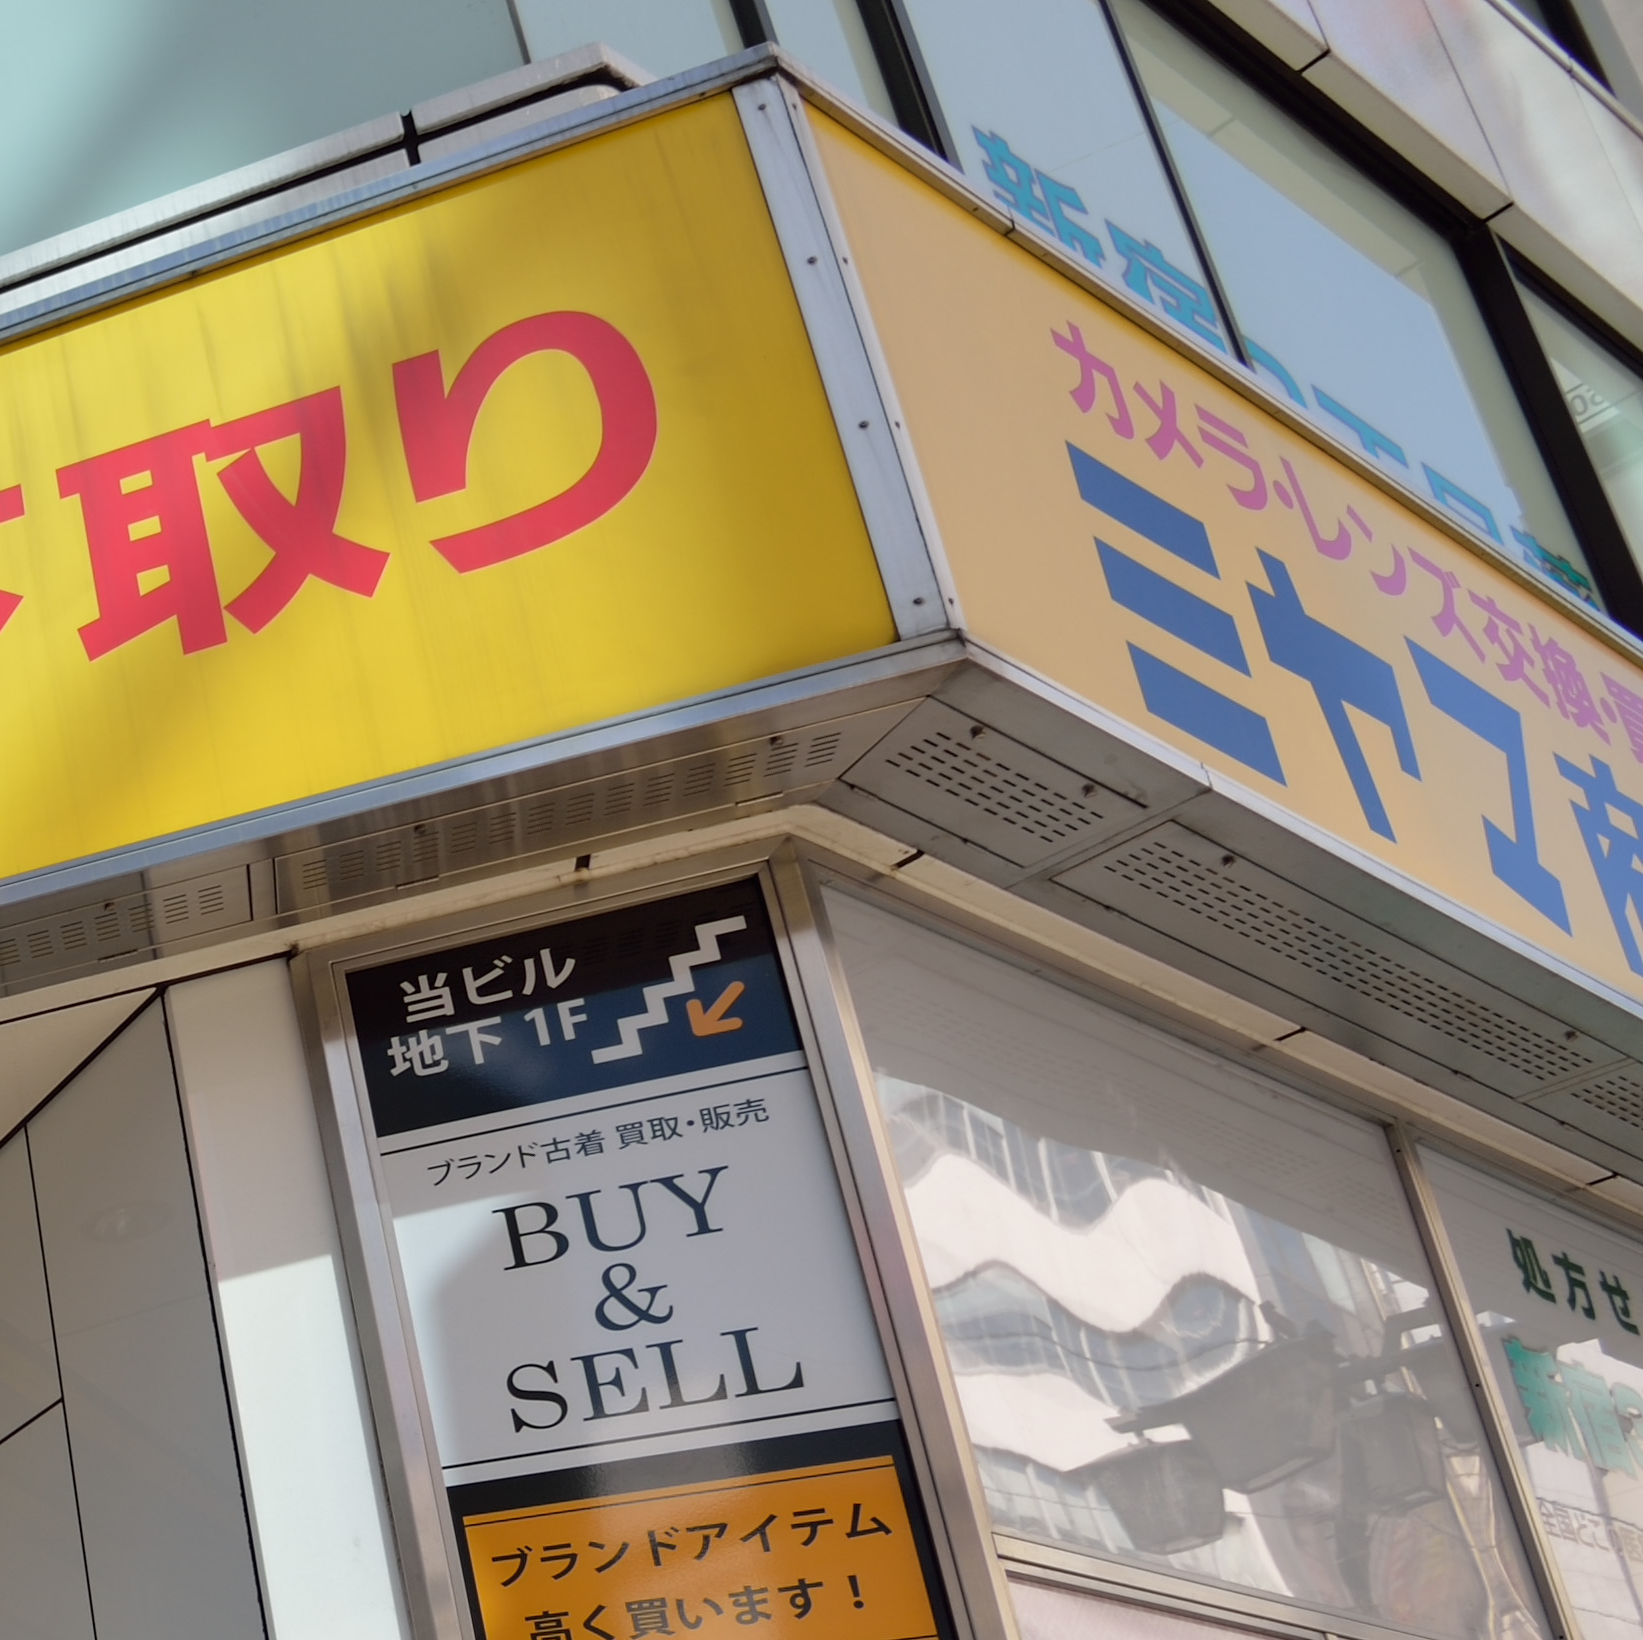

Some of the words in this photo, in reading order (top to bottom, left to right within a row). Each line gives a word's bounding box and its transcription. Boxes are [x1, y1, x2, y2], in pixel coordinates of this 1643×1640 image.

[401, 947, 576, 1023] 当ビル
[387, 1021, 503, 1079] 地下
[524, 999, 590, 1048] 1F
[427, 1130, 606, 1186] ブランド古着
[615, 1098, 769, 1151] 買取・販売
[492, 1166, 729, 1271] BUY
[594, 1262, 674, 1331] &
[506, 1327, 804, 1434] SELL
[491, 1502, 892, 1588] ブランドアイテム
